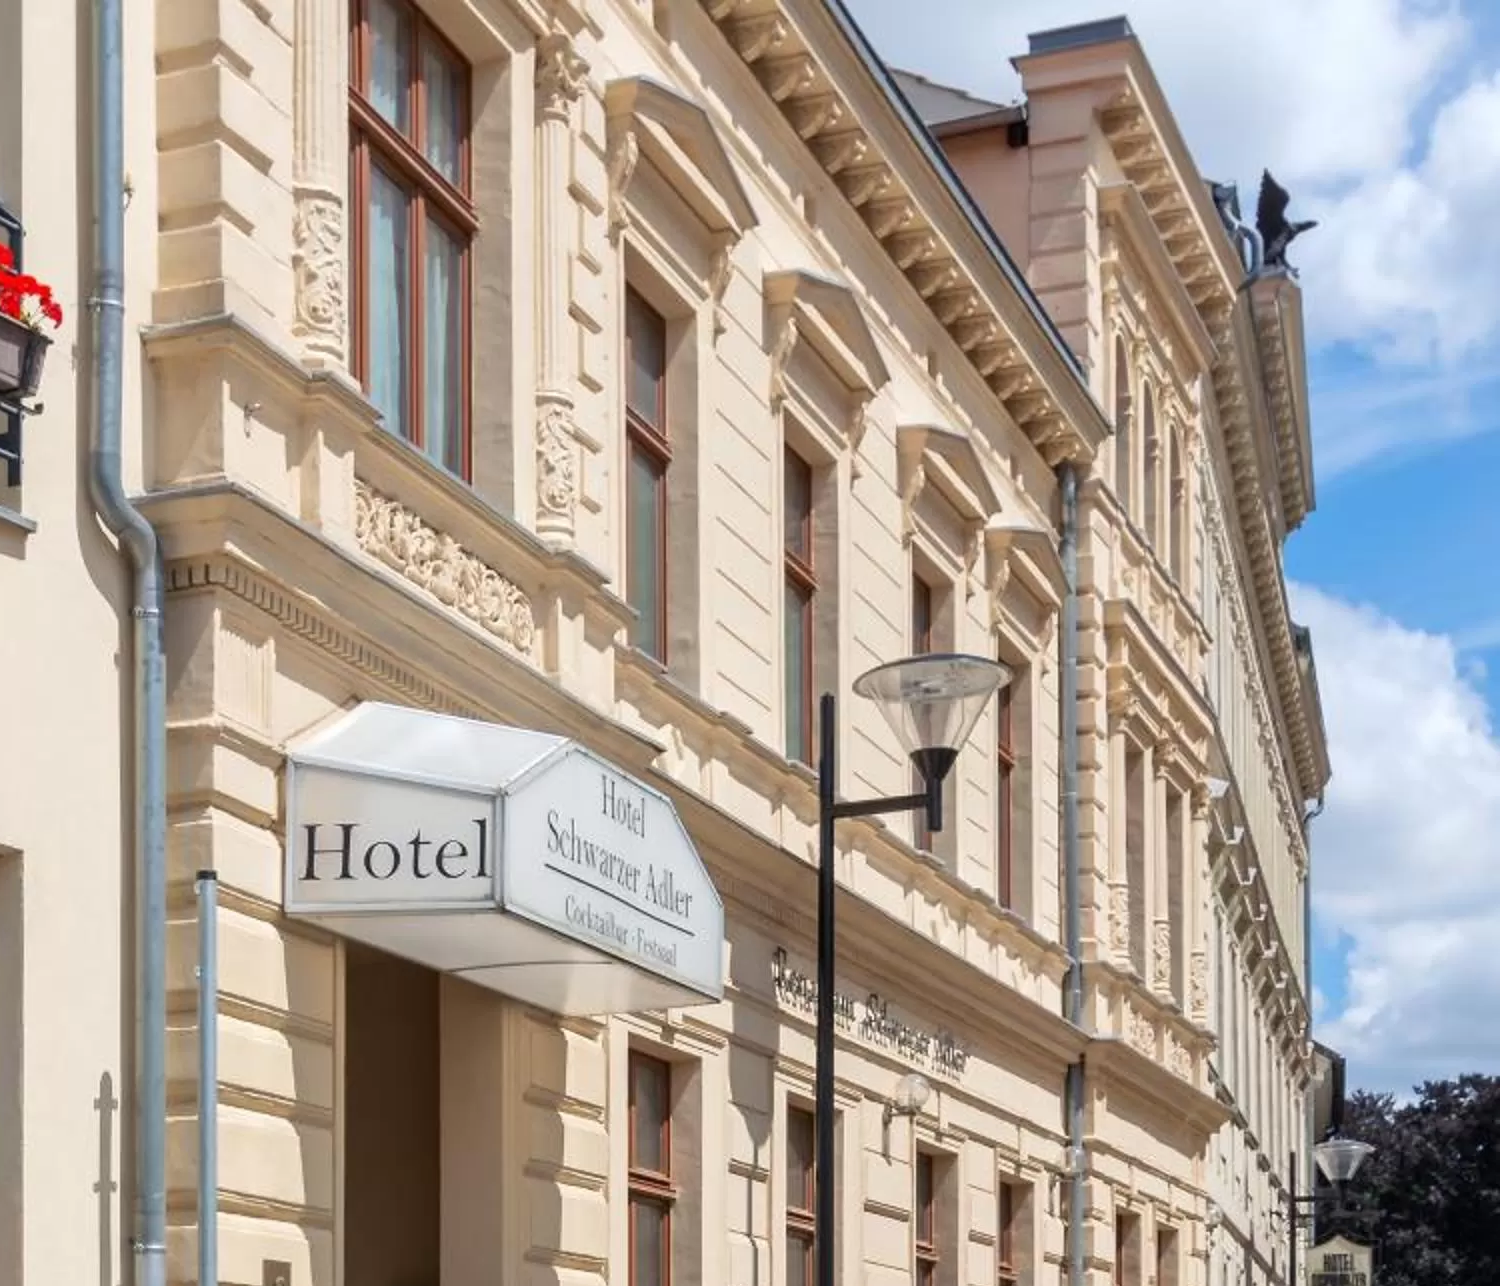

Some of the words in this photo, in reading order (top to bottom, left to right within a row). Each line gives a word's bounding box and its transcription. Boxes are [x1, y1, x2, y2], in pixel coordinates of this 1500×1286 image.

[601, 774, 645, 838] Hotel
[299, 818, 493, 881] Hotel
[547, 810, 641, 894] Schwarzer
[645, 863, 693, 919] Adler
